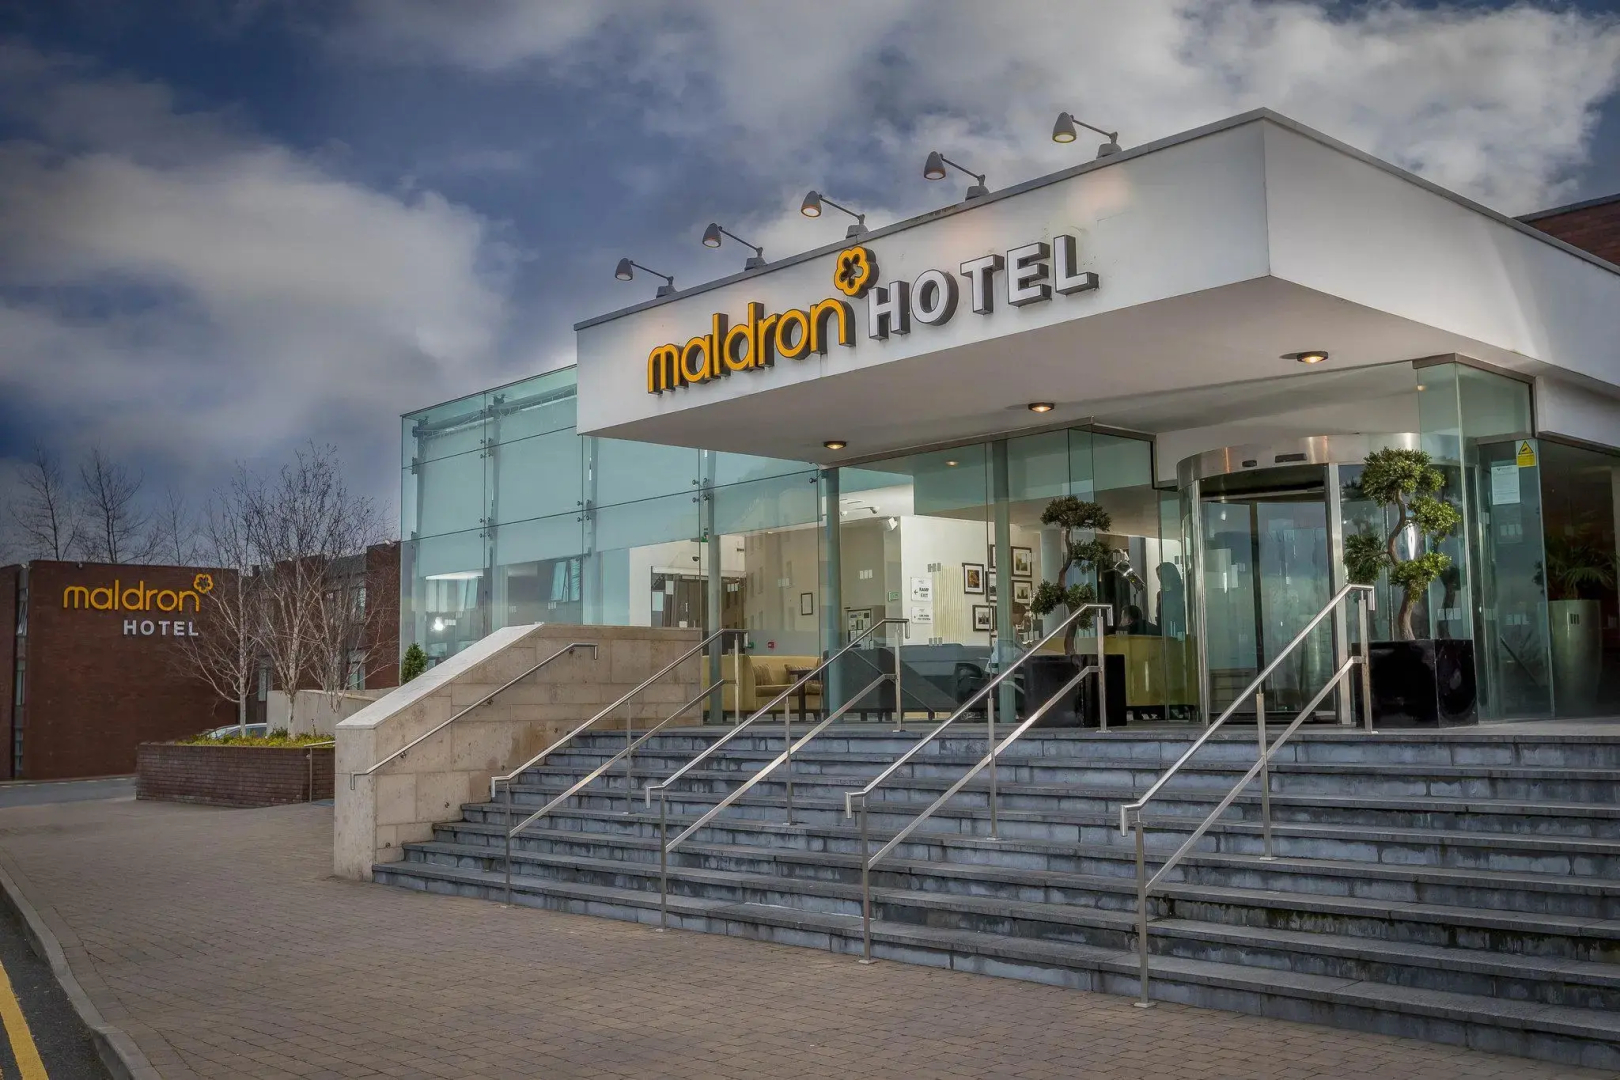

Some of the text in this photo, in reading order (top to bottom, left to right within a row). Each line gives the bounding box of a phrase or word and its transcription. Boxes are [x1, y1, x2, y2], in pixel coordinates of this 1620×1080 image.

[647, 234, 1099, 395] maldron HOTEL
[63, 579, 200, 612] maldron
[123, 620, 199, 636] HOTEL
